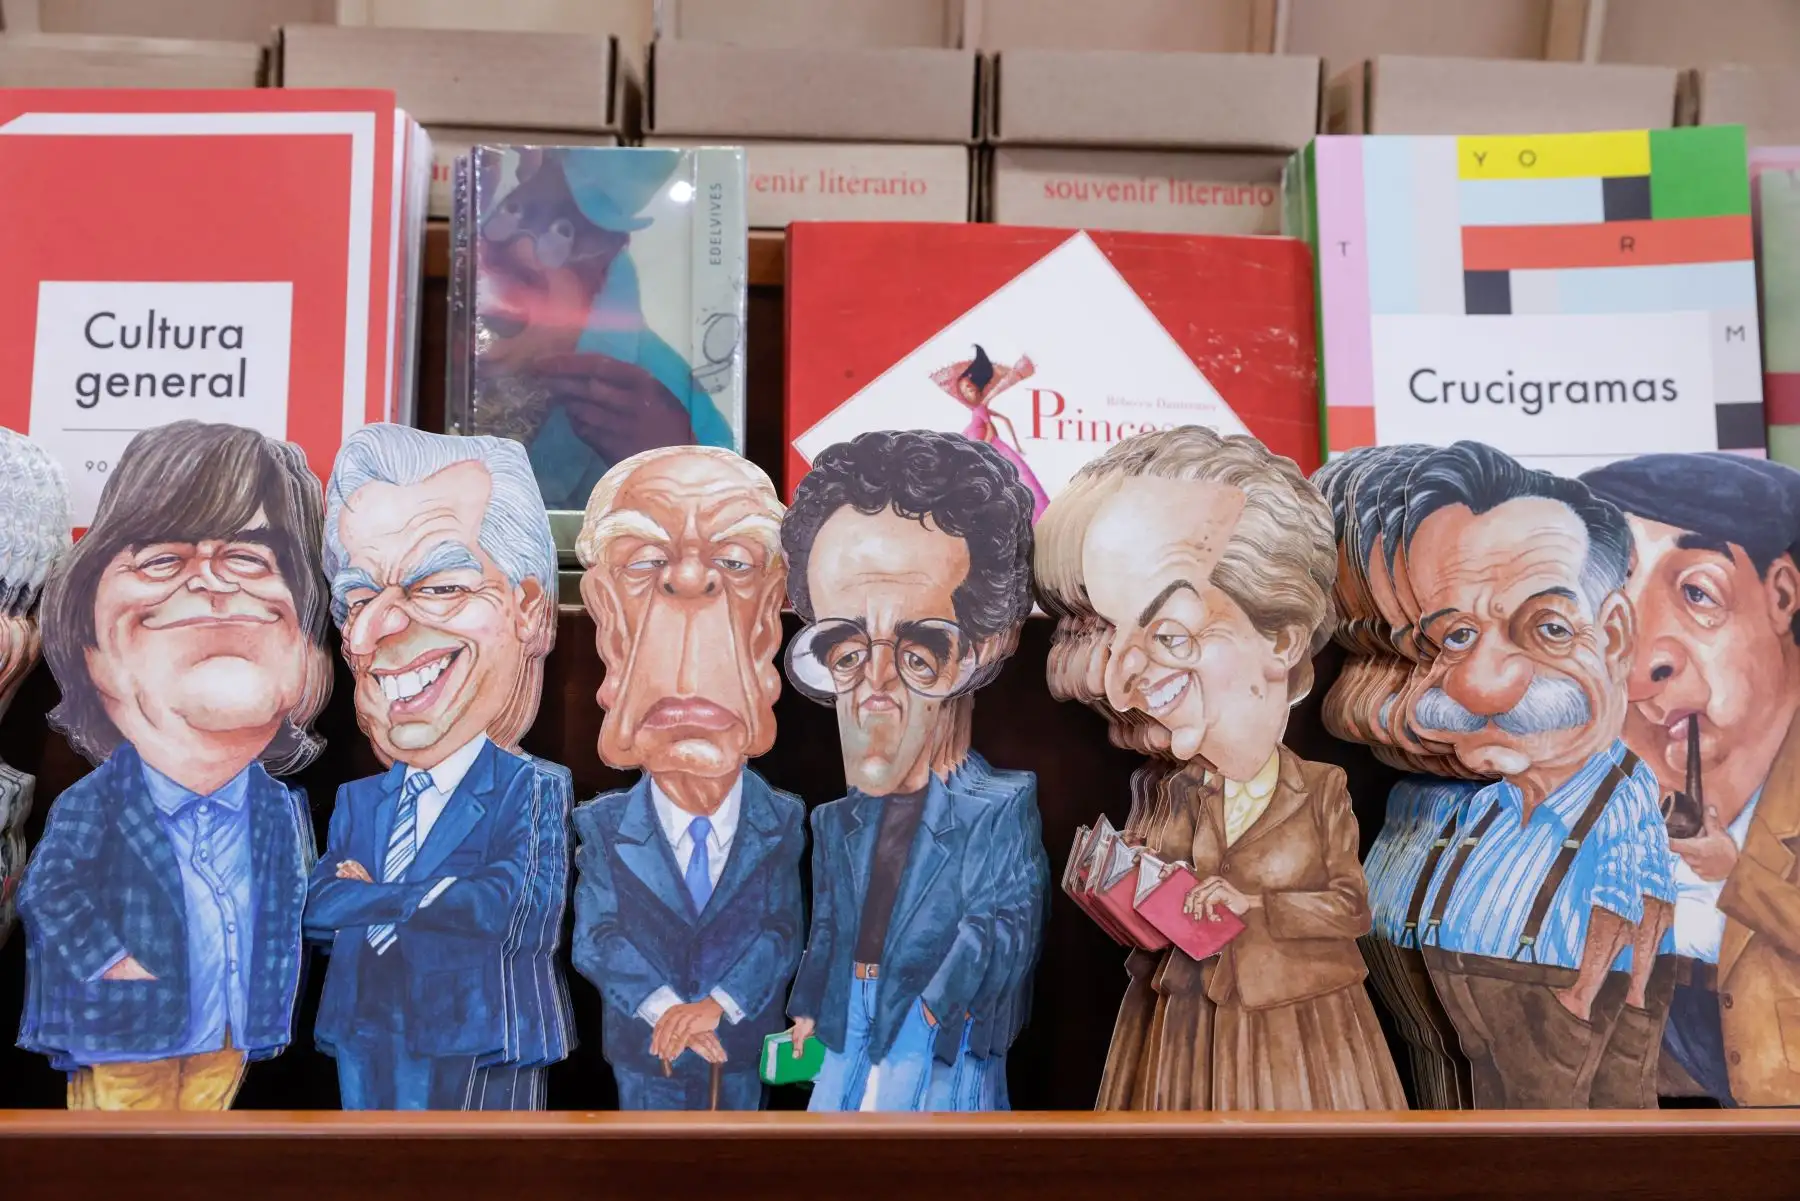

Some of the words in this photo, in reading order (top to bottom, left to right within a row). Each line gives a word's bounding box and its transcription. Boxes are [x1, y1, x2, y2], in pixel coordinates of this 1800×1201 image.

[1473, 149, 1488, 167] Y
[748, 168, 809, 194] enir
[818, 168, 928, 197] literario
[1044, 175, 1158, 204] souvenir
[1168, 177, 1275, 208] literario
[709, 182, 723, 266] EDELVIVES
[1336, 241, 1351, 257] T
[1620, 236, 1636, 253] R
[84, 308, 244, 350] Cultura
[1726, 325, 1746, 343] M
[75, 357, 247, 409] general
[1408, 368, 1679, 416] Crucigramas
[1024, 387, 1219, 442] Prince
[85, 460, 108, 473] 90
